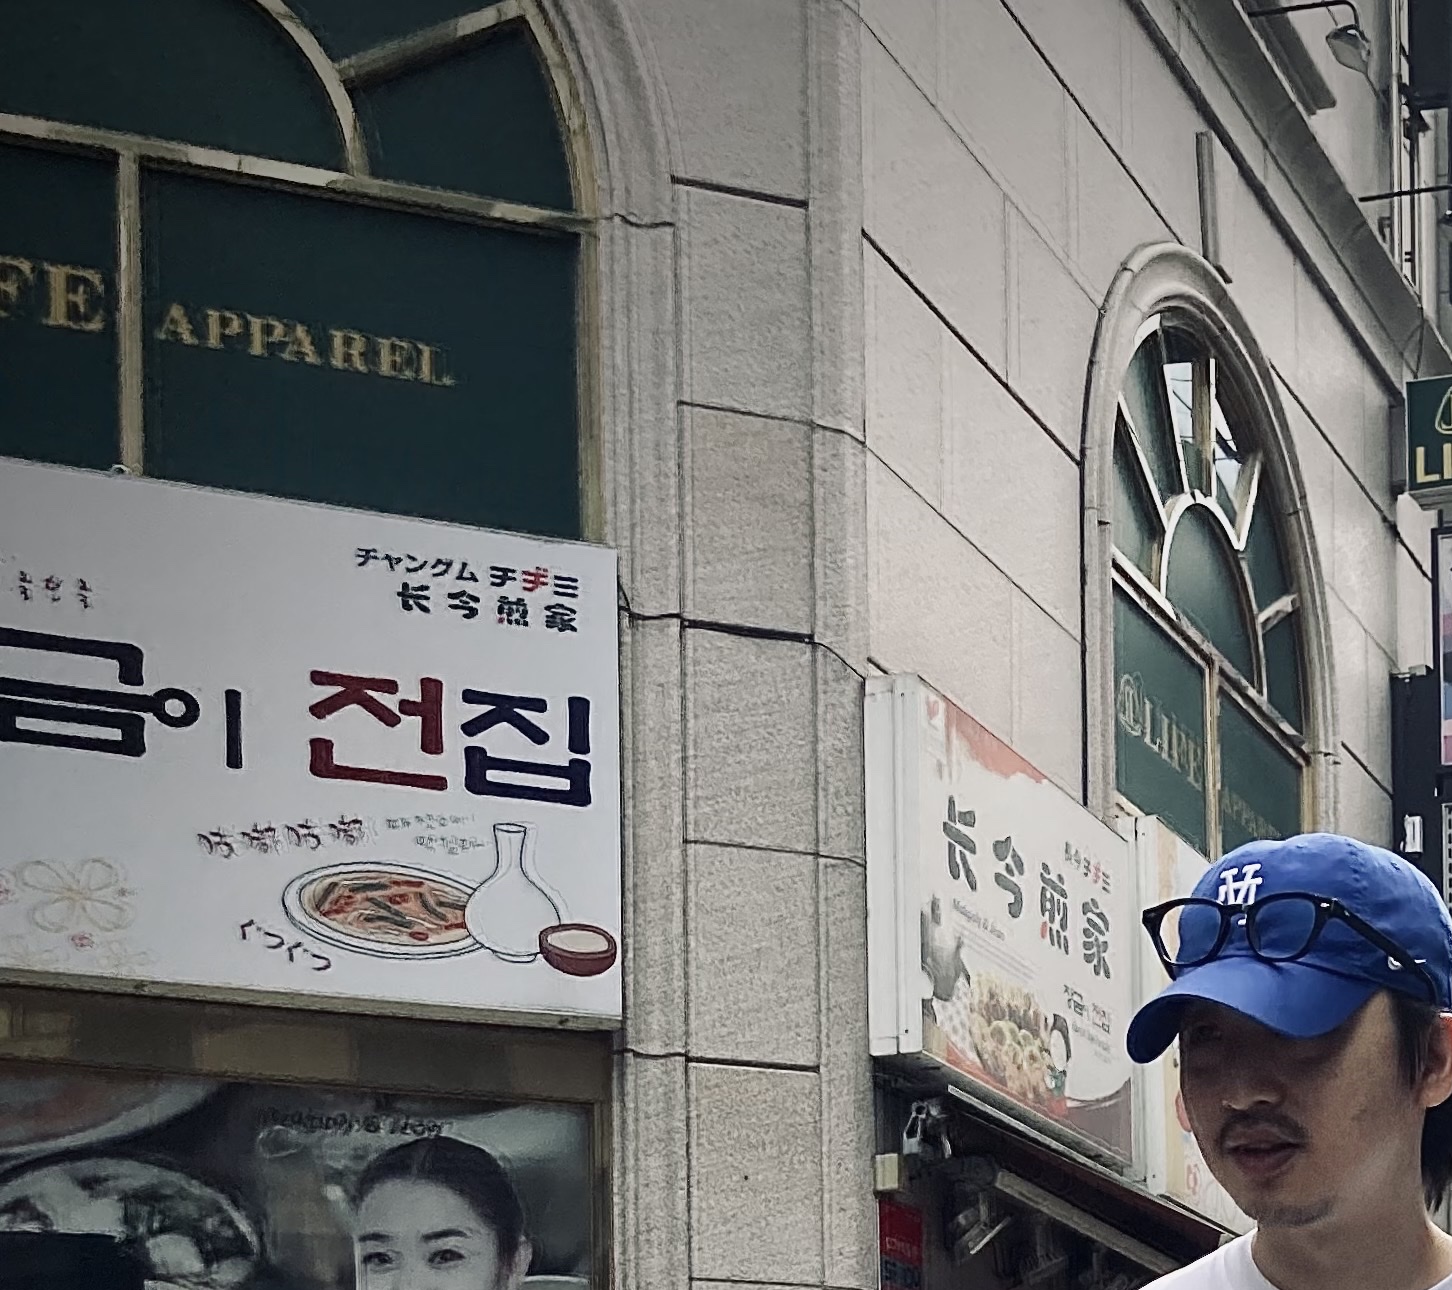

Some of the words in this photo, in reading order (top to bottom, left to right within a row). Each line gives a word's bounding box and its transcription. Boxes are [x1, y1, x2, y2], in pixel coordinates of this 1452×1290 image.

[156, 302, 456, 388] APPAREL
[355, 546, 479, 584] チャングム
[397, 582, 579, 634] 长今煎家
[307, 669, 593, 808] 전집
